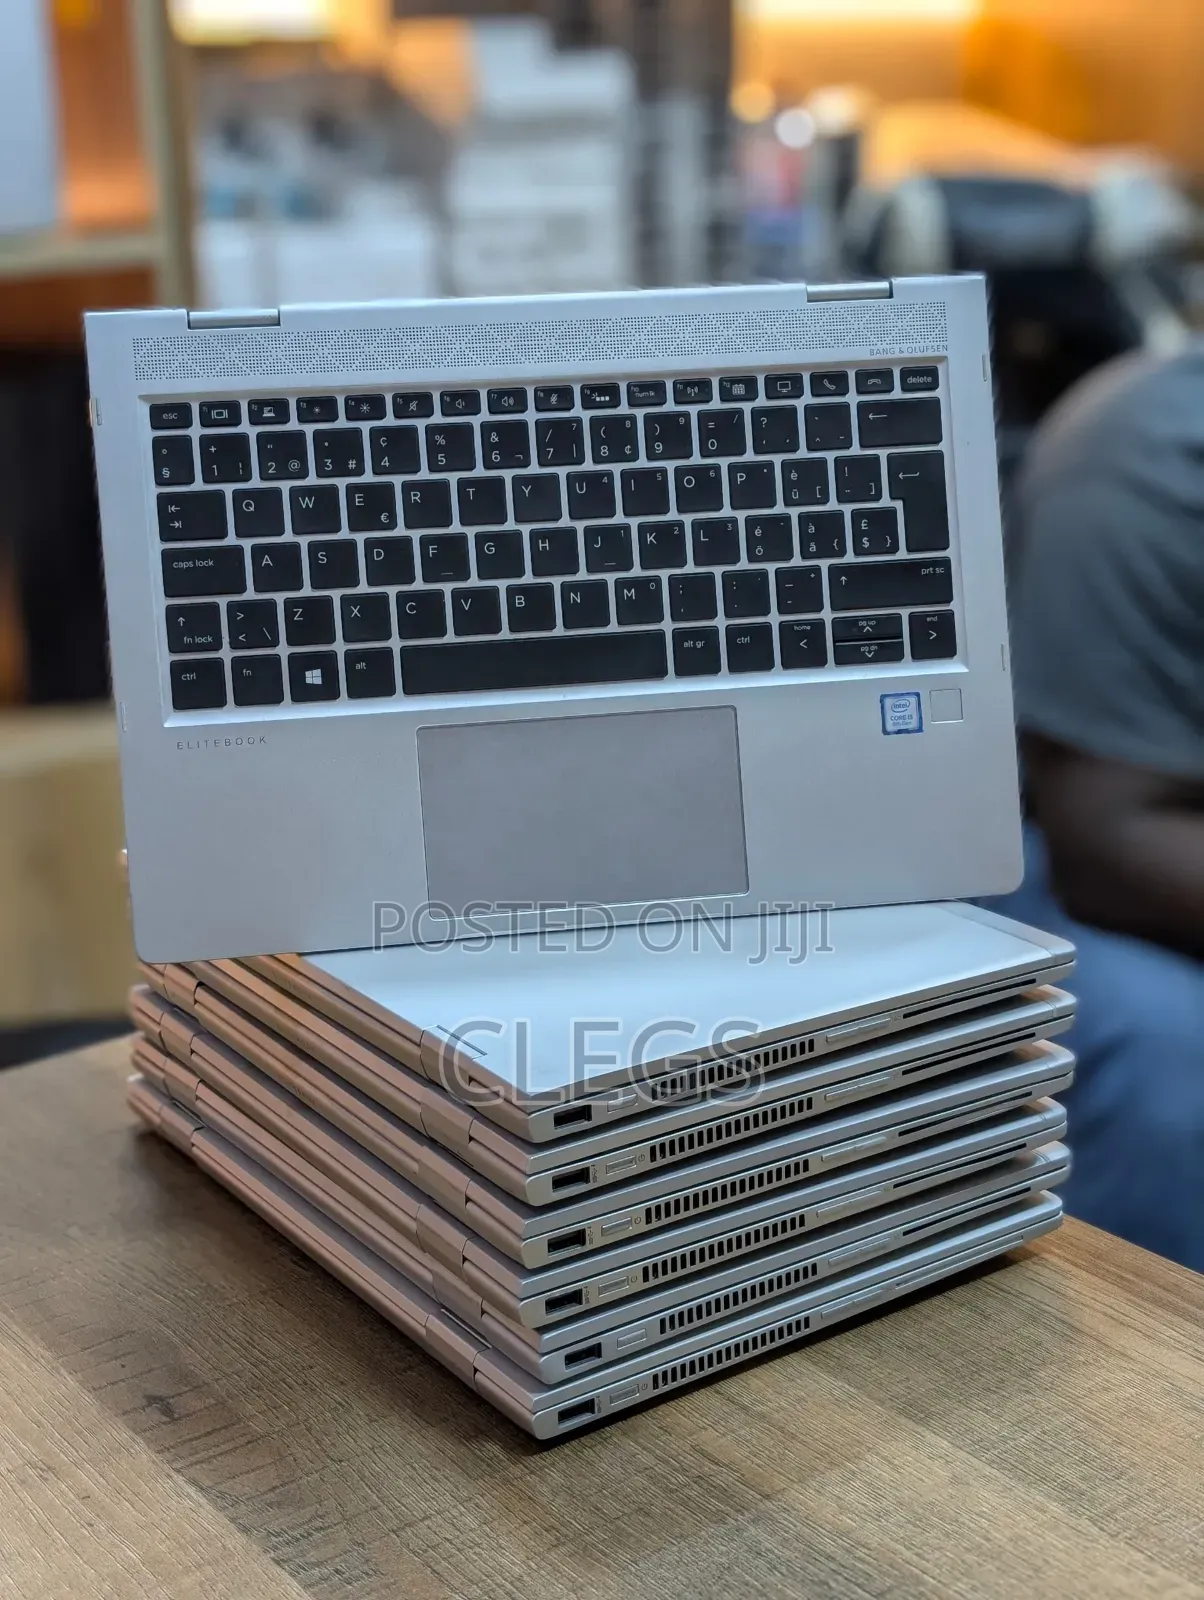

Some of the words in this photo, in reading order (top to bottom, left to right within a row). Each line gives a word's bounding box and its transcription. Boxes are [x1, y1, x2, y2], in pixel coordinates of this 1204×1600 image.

[869, 348, 895, 356] BANG
[907, 345, 948, 354] OLUFSEN
[906, 375, 933, 384] delete
[162, 412, 178, 420] esc
[760, 416, 768, 428] ?
[434, 434, 446, 446] %
[490, 431, 500, 443] &
[654, 441, 663, 454] 9
[707, 438, 718, 450] 0
[491, 450, 501, 463] 6
[545, 447, 554, 460] 7
[600, 445, 609, 457] 8
[324, 458, 333, 471] 3
[347, 458, 357, 470] #
[380, 455, 390, 468] 4
[437, 453, 446, 465] 5
[267, 461, 277, 474] 2
[287, 459, 301, 473] @
[683, 475, 696, 488] O
[736, 472, 747, 485] P
[521, 484, 532, 498] Y
[575, 481, 587, 494] U
[354, 493, 365, 506] E
[410, 491, 421, 504] R
[465, 488, 476, 501] T
[242, 499, 255, 512] Q
[298, 495, 315, 509] W
[380, 512, 390, 524] €
[860, 518, 869, 530] £
[593, 535, 602, 548] J
[646, 532, 657, 545] K
[700, 529, 710, 542] L
[484, 542, 496, 555] G
[538, 538, 550, 552] H
[861, 536, 870, 549] $
[317, 551, 328, 564] S
[373, 548, 385, 561] D
[428, 545, 438, 558] F
[172, 560, 195, 570] caps
[195, 558, 215, 567] lock
[261, 554, 274, 567] A
[920, 566, 934, 576] prt
[570, 591, 581, 604] N
[623, 587, 636, 601] M
[405, 601, 417, 615] C
[460, 598, 472, 611] V
[515, 595, 526, 608] B
[292, 608, 304, 621] Z
[350, 605, 361, 618] X
[183, 635, 193, 645] fn
[194, 634, 213, 644] lock
[683, 639, 694, 648] alt
[695, 640, 706, 649] gr
[736, 635, 751, 644] ctrl
[355, 661, 367, 670] alt
[181, 671, 197, 681] ctrl
[242, 668, 252, 677] fn
[176, 736, 267, 750] ELITEBOOK
